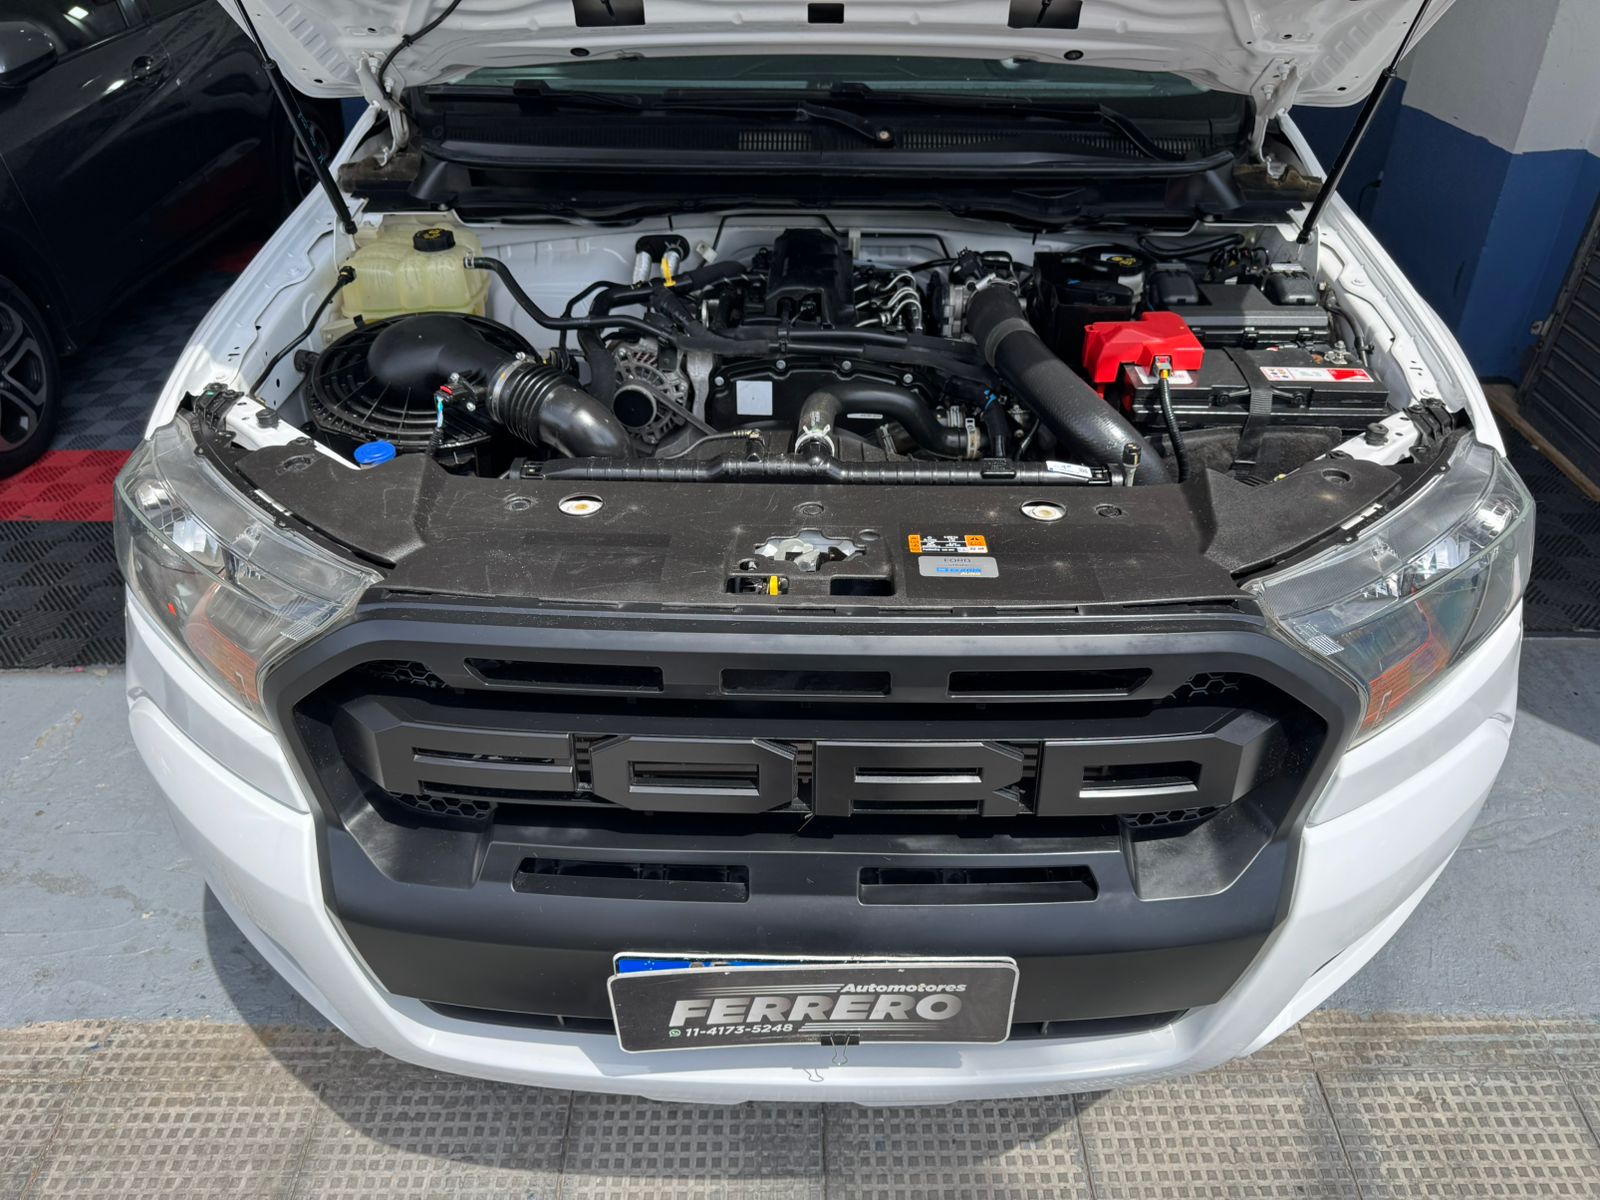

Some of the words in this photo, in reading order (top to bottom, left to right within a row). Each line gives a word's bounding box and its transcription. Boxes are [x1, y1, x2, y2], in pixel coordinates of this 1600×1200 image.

[364, 720, 1262, 818] FORD
[840, 983, 967, 993] Automotores
[669, 993, 963, 1027] FERRERO
[685, 1024, 794, 1037] 11-4173-5248
